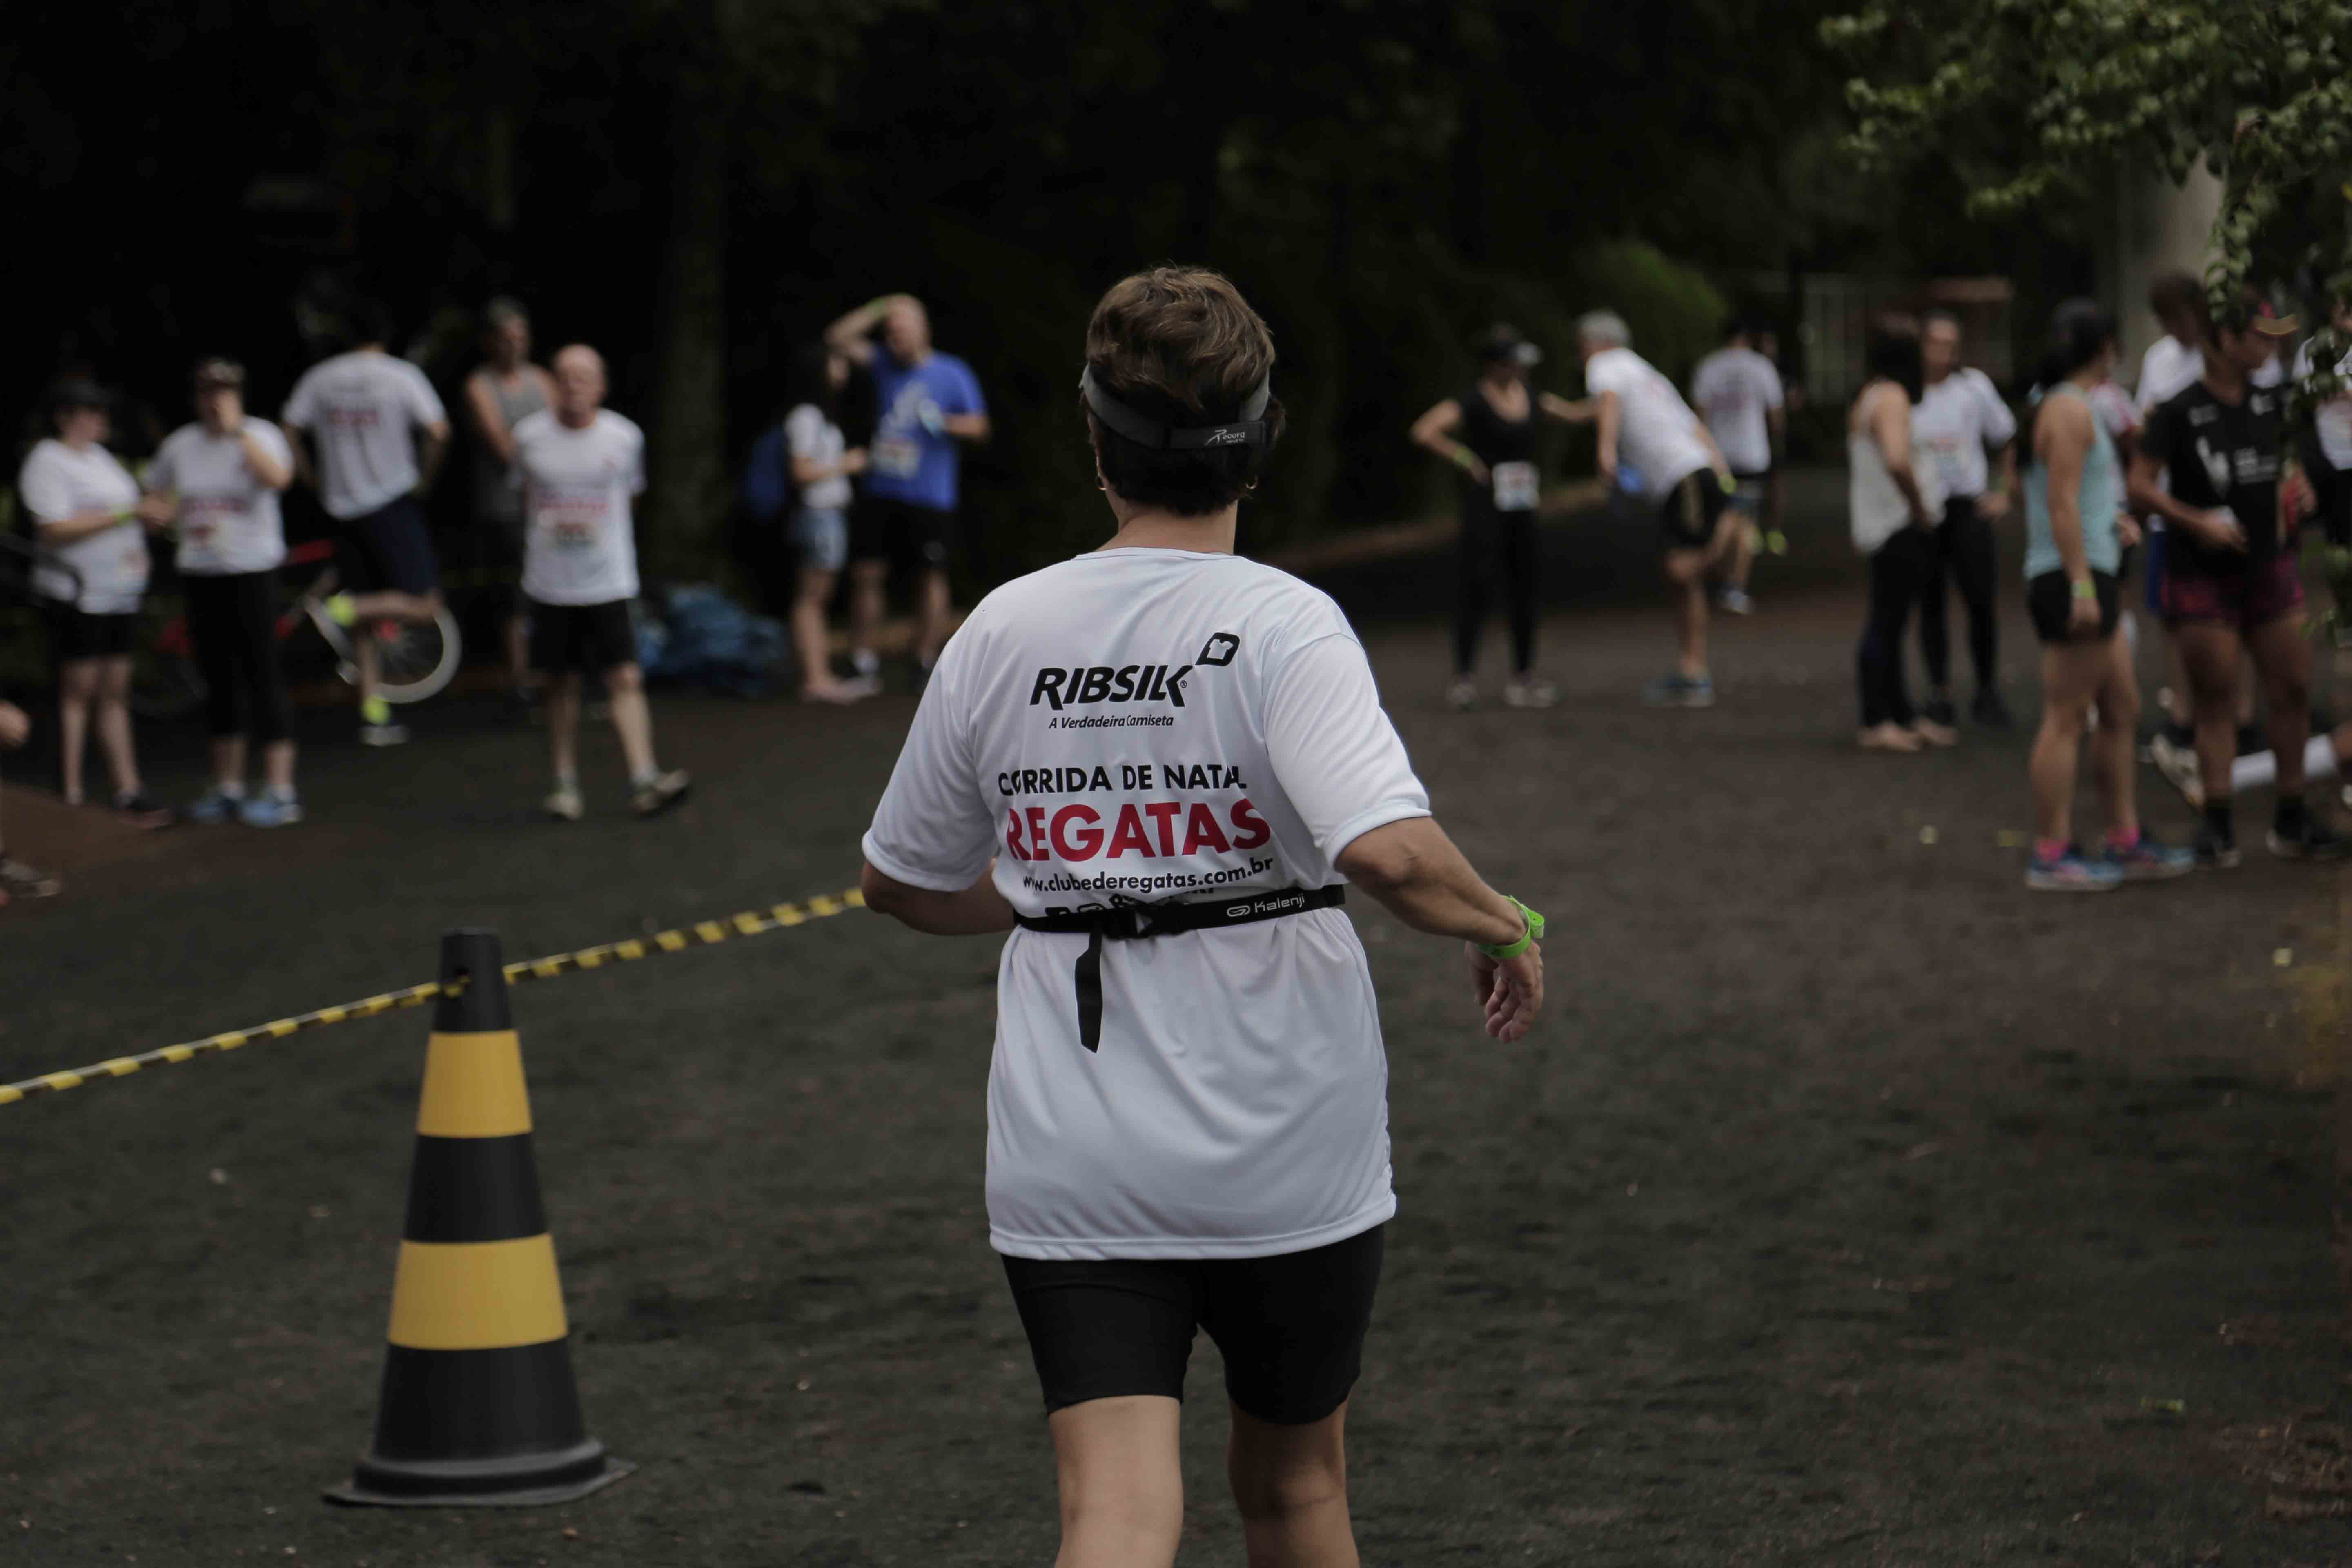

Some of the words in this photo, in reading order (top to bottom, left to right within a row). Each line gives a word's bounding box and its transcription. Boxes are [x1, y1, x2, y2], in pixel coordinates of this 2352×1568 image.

[1030, 665, 1193, 710] RIBSILK
[1049, 717, 1058, 729] A
[1061, 716, 1125, 729] Verdadeira
[1126, 714, 1174, 727] Camiseta
[998, 766, 1113, 796] CORRIDA
[1122, 765, 1153, 791] DE
[1006, 798, 1271, 862] REGATAS
[1254, 893, 1305, 913] Kalenji
